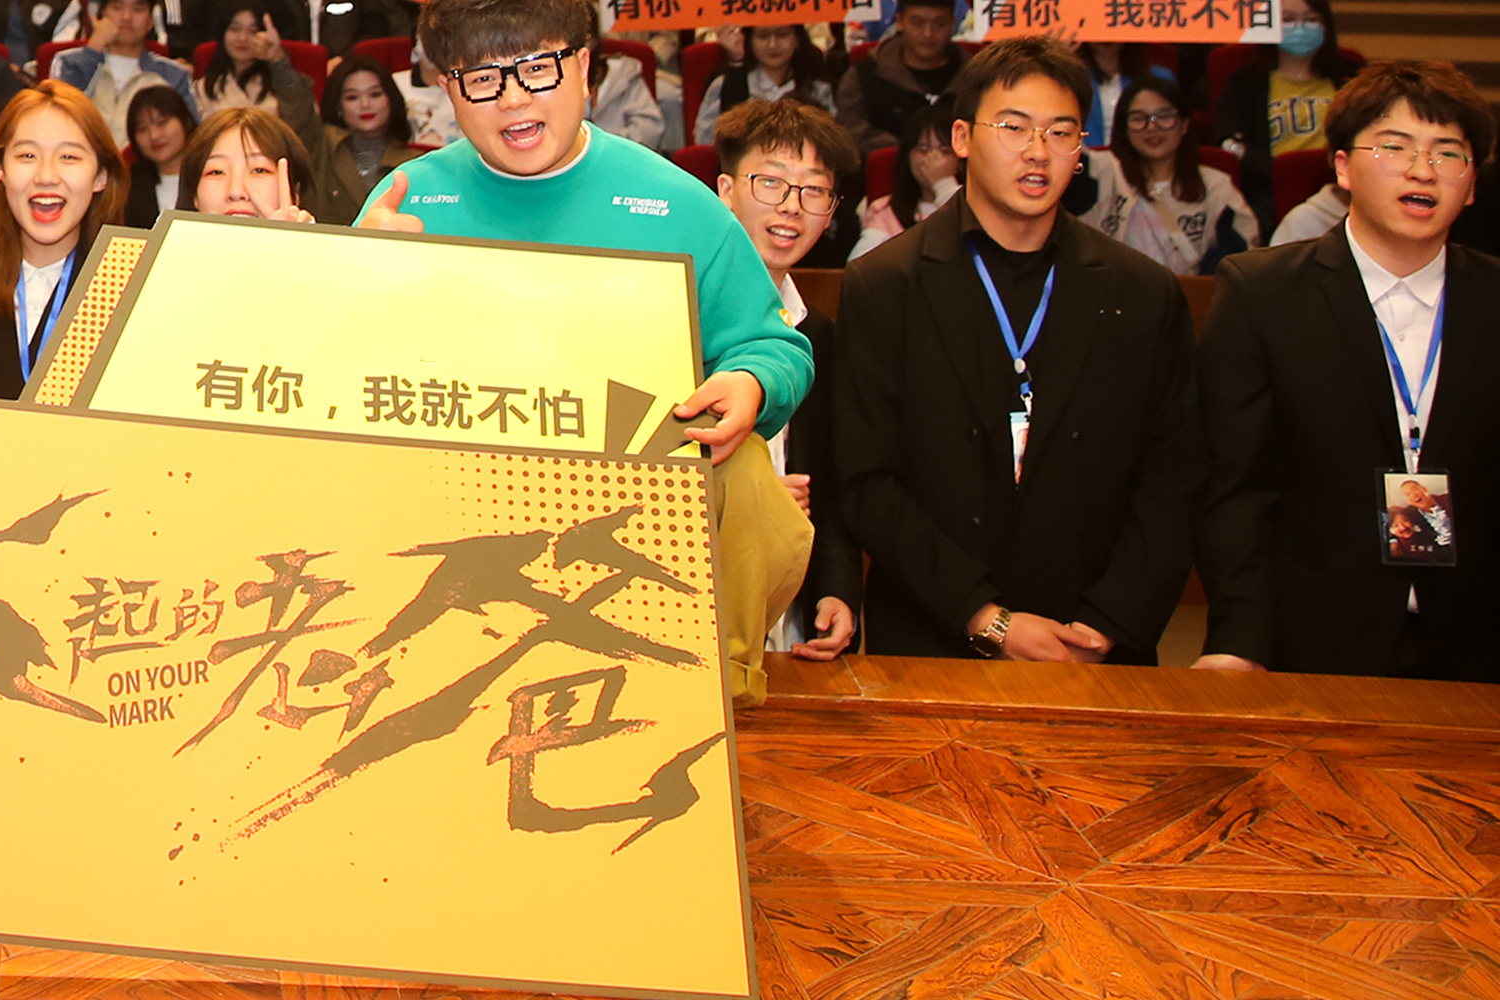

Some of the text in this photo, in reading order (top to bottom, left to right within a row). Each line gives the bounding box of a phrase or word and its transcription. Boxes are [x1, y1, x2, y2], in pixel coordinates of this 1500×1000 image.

[195, 358, 587, 438] 有你，我就不怕
[107, 660, 209, 697] ON YOUR
[109, 695, 176, 729] MARK
